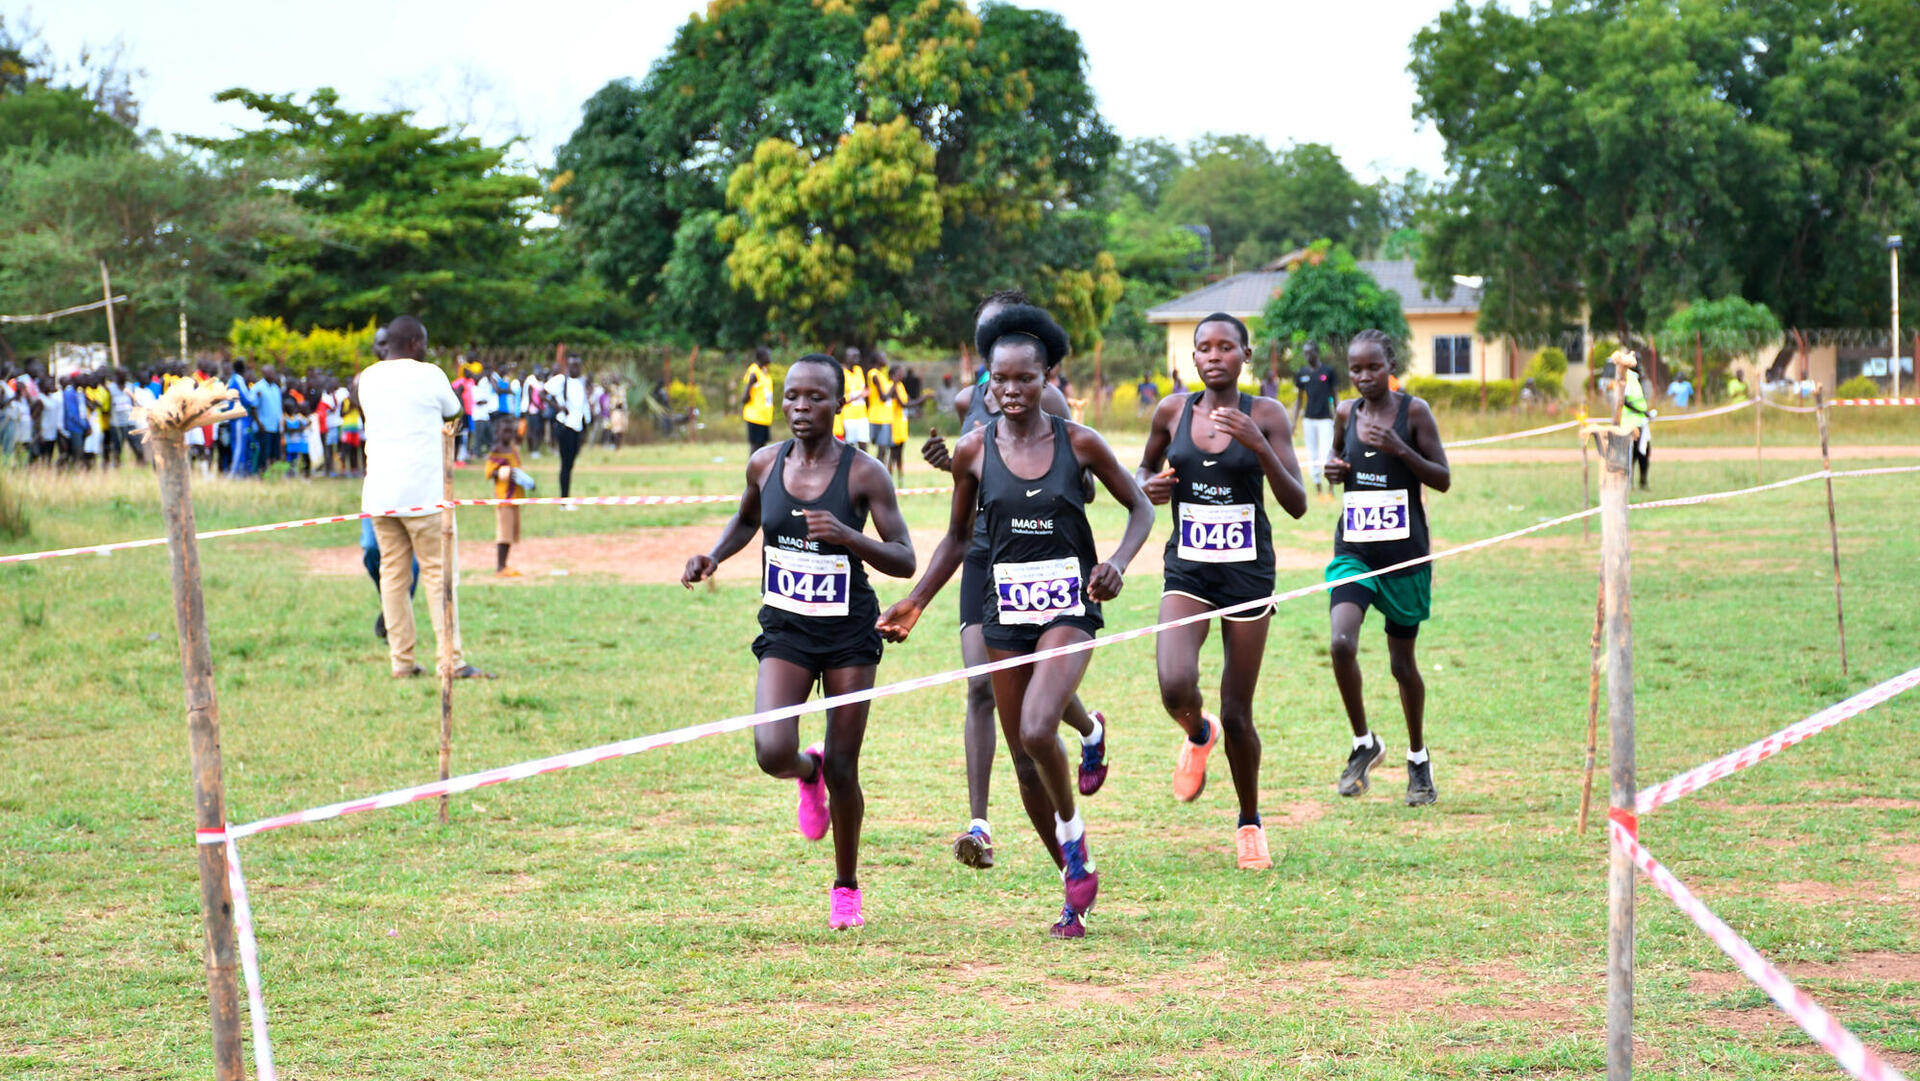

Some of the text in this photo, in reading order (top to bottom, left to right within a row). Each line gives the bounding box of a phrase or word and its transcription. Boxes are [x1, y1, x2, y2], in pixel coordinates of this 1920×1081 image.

[1356, 472, 1387, 483] IMAGINE
[1192, 482, 1232, 496] IMAGINE
[1011, 518, 1054, 530] IMAGINE
[1353, 505, 1400, 530] 045
[777, 535, 820, 552] IMAGINE
[1190, 522, 1245, 550] 046
[777, 569, 837, 602] 044
[1008, 579, 1072, 611] 063
